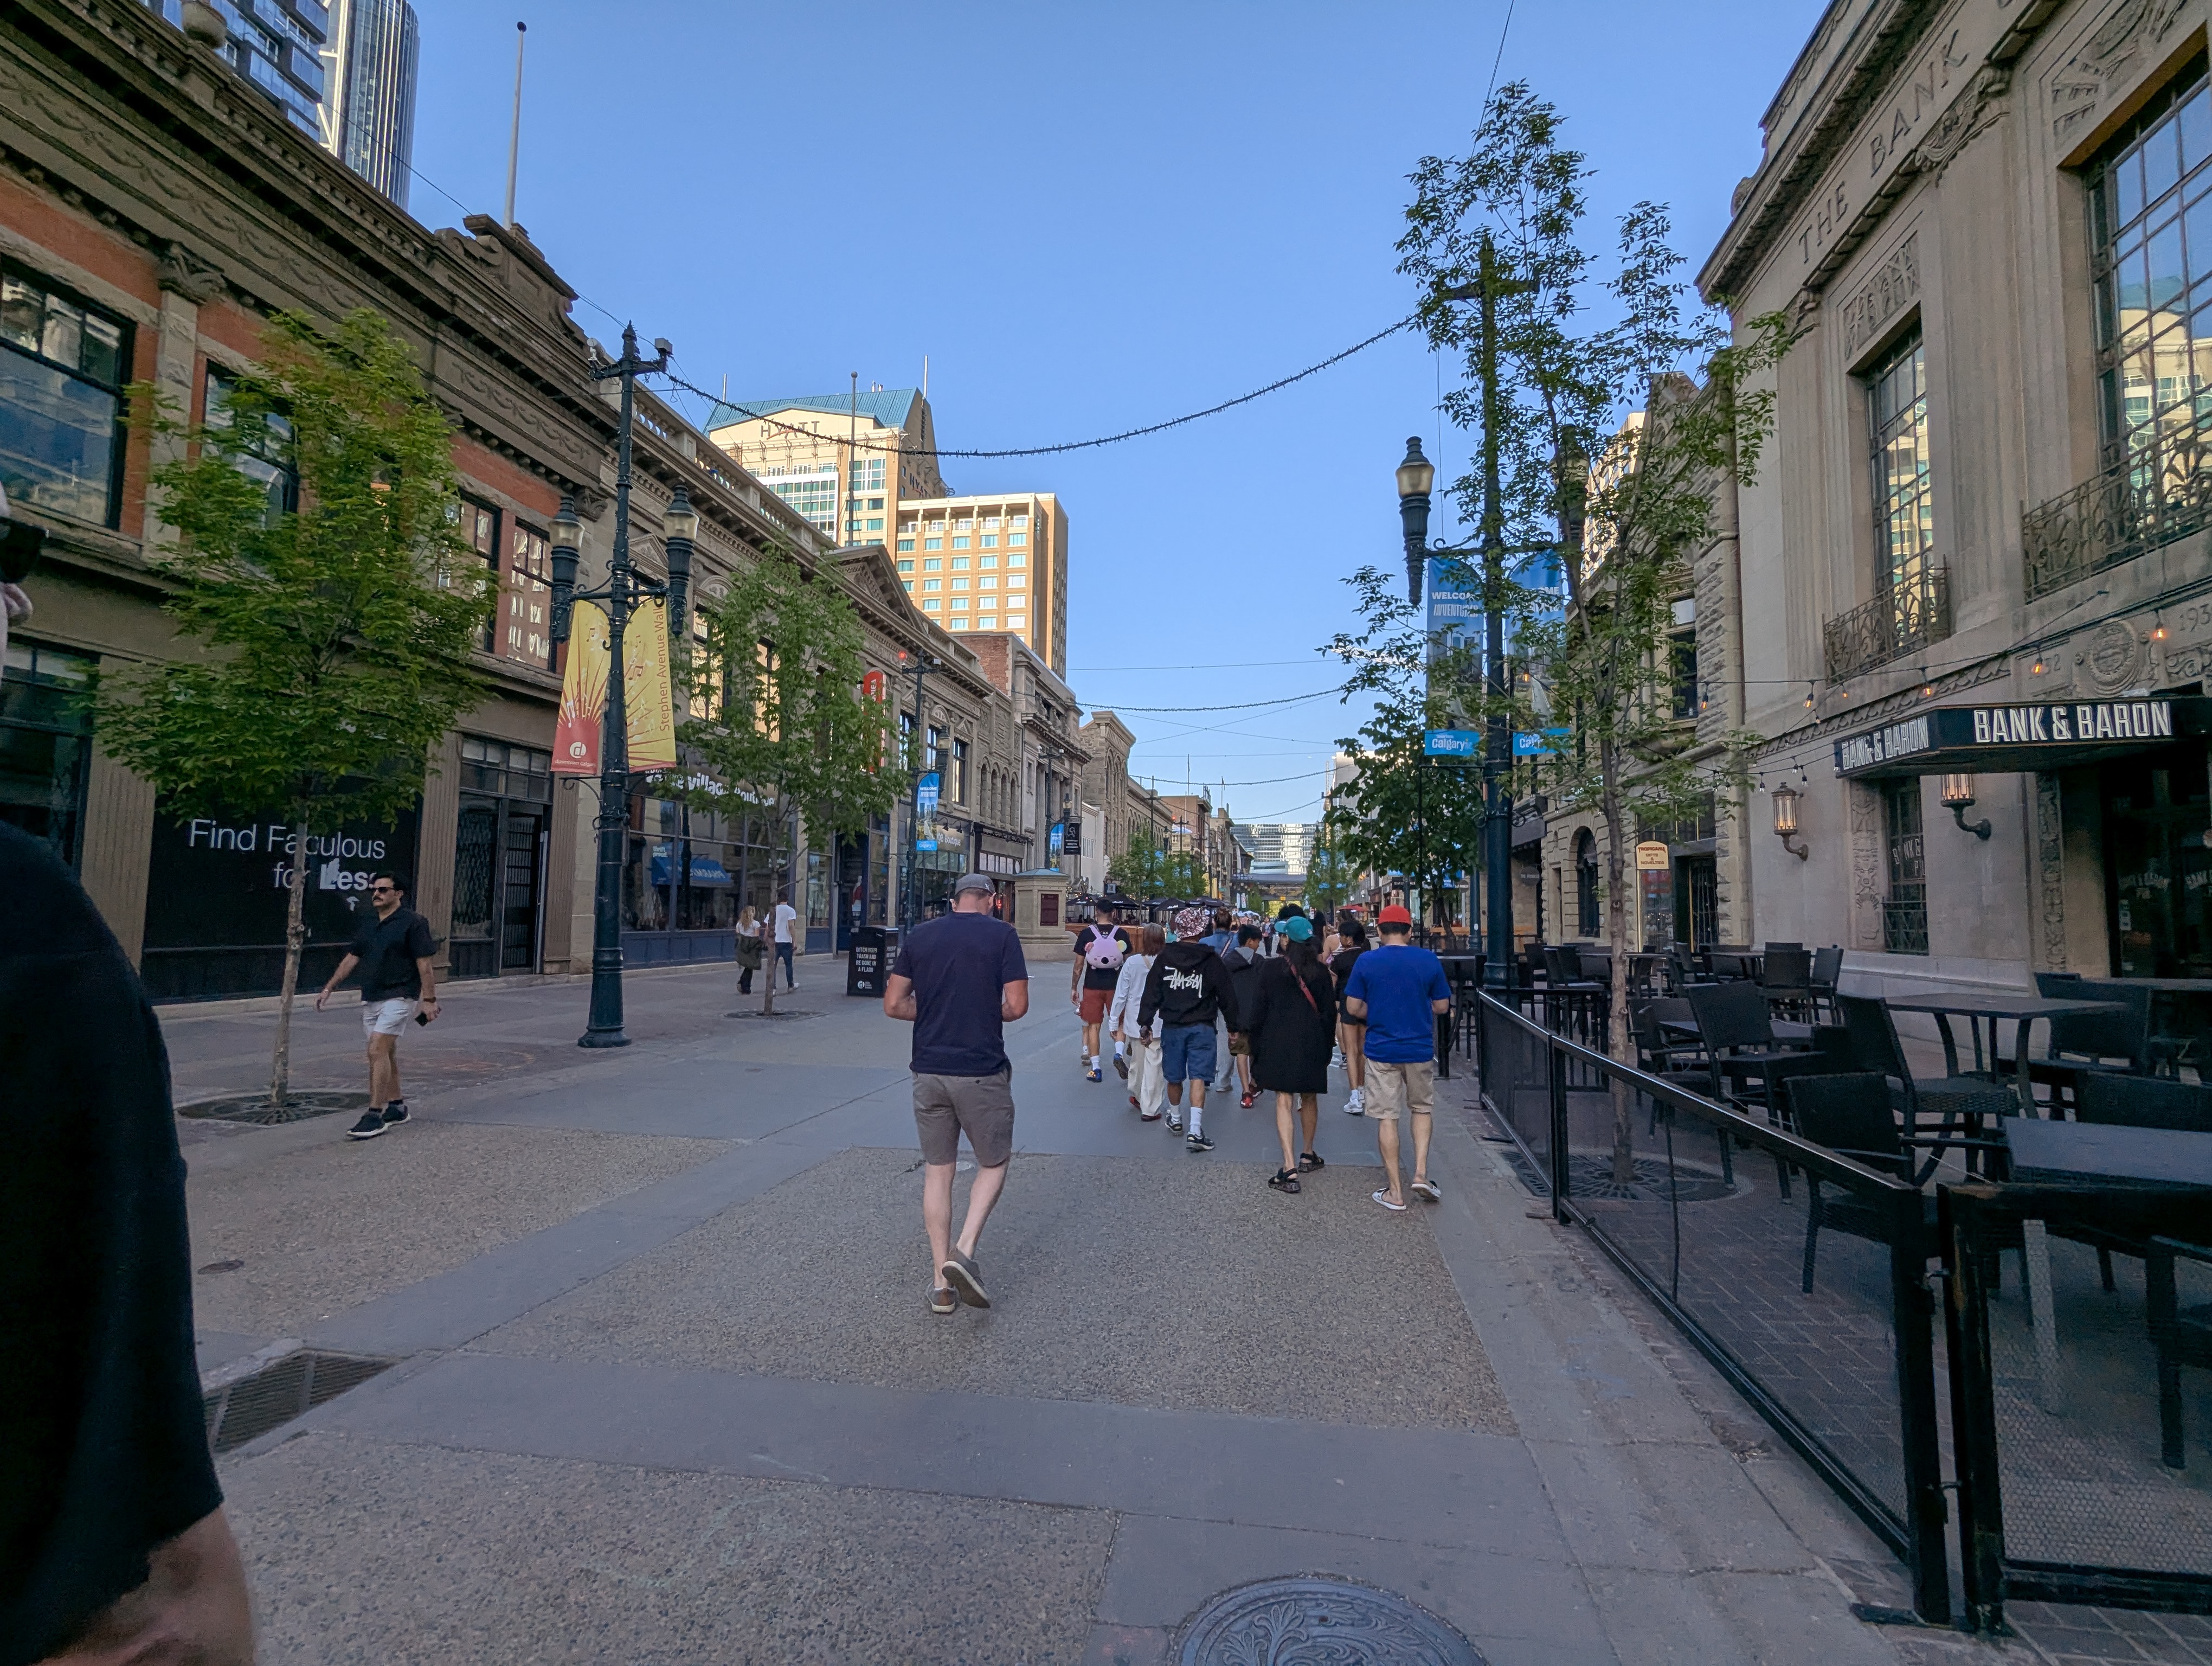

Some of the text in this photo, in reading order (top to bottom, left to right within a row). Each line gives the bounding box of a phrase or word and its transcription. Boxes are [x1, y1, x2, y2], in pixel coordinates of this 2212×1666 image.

[1798, 29, 1969, 264] THE BANK
[761, 421, 820, 438] HYATT
[1431, 592, 1481, 600] WELCO
[656, 633, 667, 678] Avenue
[658, 681, 671, 732] Stephen
[1973, 701, 2171, 743] BANK & BARON
[1432, 738, 1465, 752] Calgary
[1841, 715, 1930, 771] BANK & BARON
[190, 818, 258, 851] Find
[1892, 839, 1914, 865] BNK
